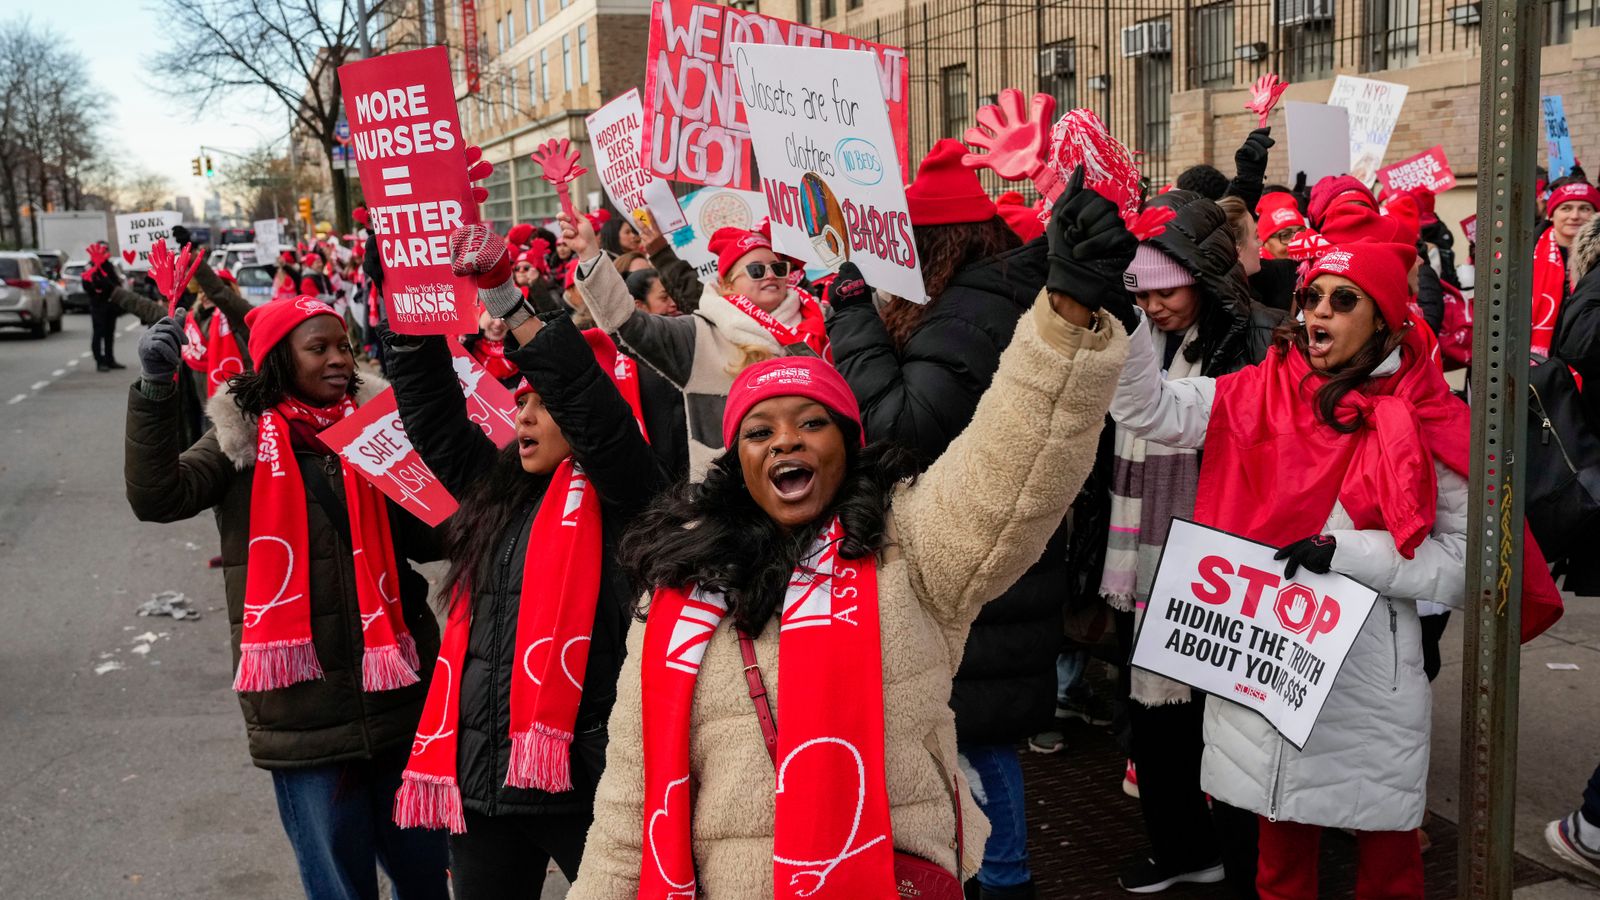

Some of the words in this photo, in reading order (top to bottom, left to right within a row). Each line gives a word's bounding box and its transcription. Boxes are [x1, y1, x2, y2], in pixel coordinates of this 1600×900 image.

[661, 0, 720, 62] WE
[355, 84, 430, 125] MORE
[655, 50, 750, 132] NONE
[736, 46, 796, 117] Closets
[801, 87, 828, 122] are
[831, 78, 860, 128] for
[353, 119, 456, 162] NURSES
[595, 112, 640, 151] HOSPITAL
[606, 135, 635, 164] EXECS
[602, 151, 641, 186] LITERALL
[785, 131, 836, 177] clothes
[1386, 154, 1435, 180] NURSES
[610, 174, 638, 200] MAKE
[636, 167, 653, 188] US
[1388, 160, 1443, 191] DESERVE
[370, 199, 465, 236] BETTER
[622, 190, 648, 214] SICK
[763, 177, 804, 232] NOT
[128, 233, 140, 244] IF
[147, 229, 170, 242] YOU
[129, 217, 164, 230] HONK
[841, 197, 916, 270] BABIES
[381, 235, 453, 269] CARE
[392, 291, 457, 315] NURSES
[404, 285, 420, 294] New
[420, 283, 437, 293] York
[437, 282, 454, 292] State
[397, 312, 459, 324] ASSOCIATION
[358, 428, 403, 466] SAFE
[399, 456, 437, 494] SAV
[1165, 597, 1244, 644] HIDING
[1248, 624, 1290, 662] THE
[1287, 641, 1326, 686] TRUTH
[1164, 628, 1242, 672] ABOUT
[1245, 653, 1289, 697] YOUR
